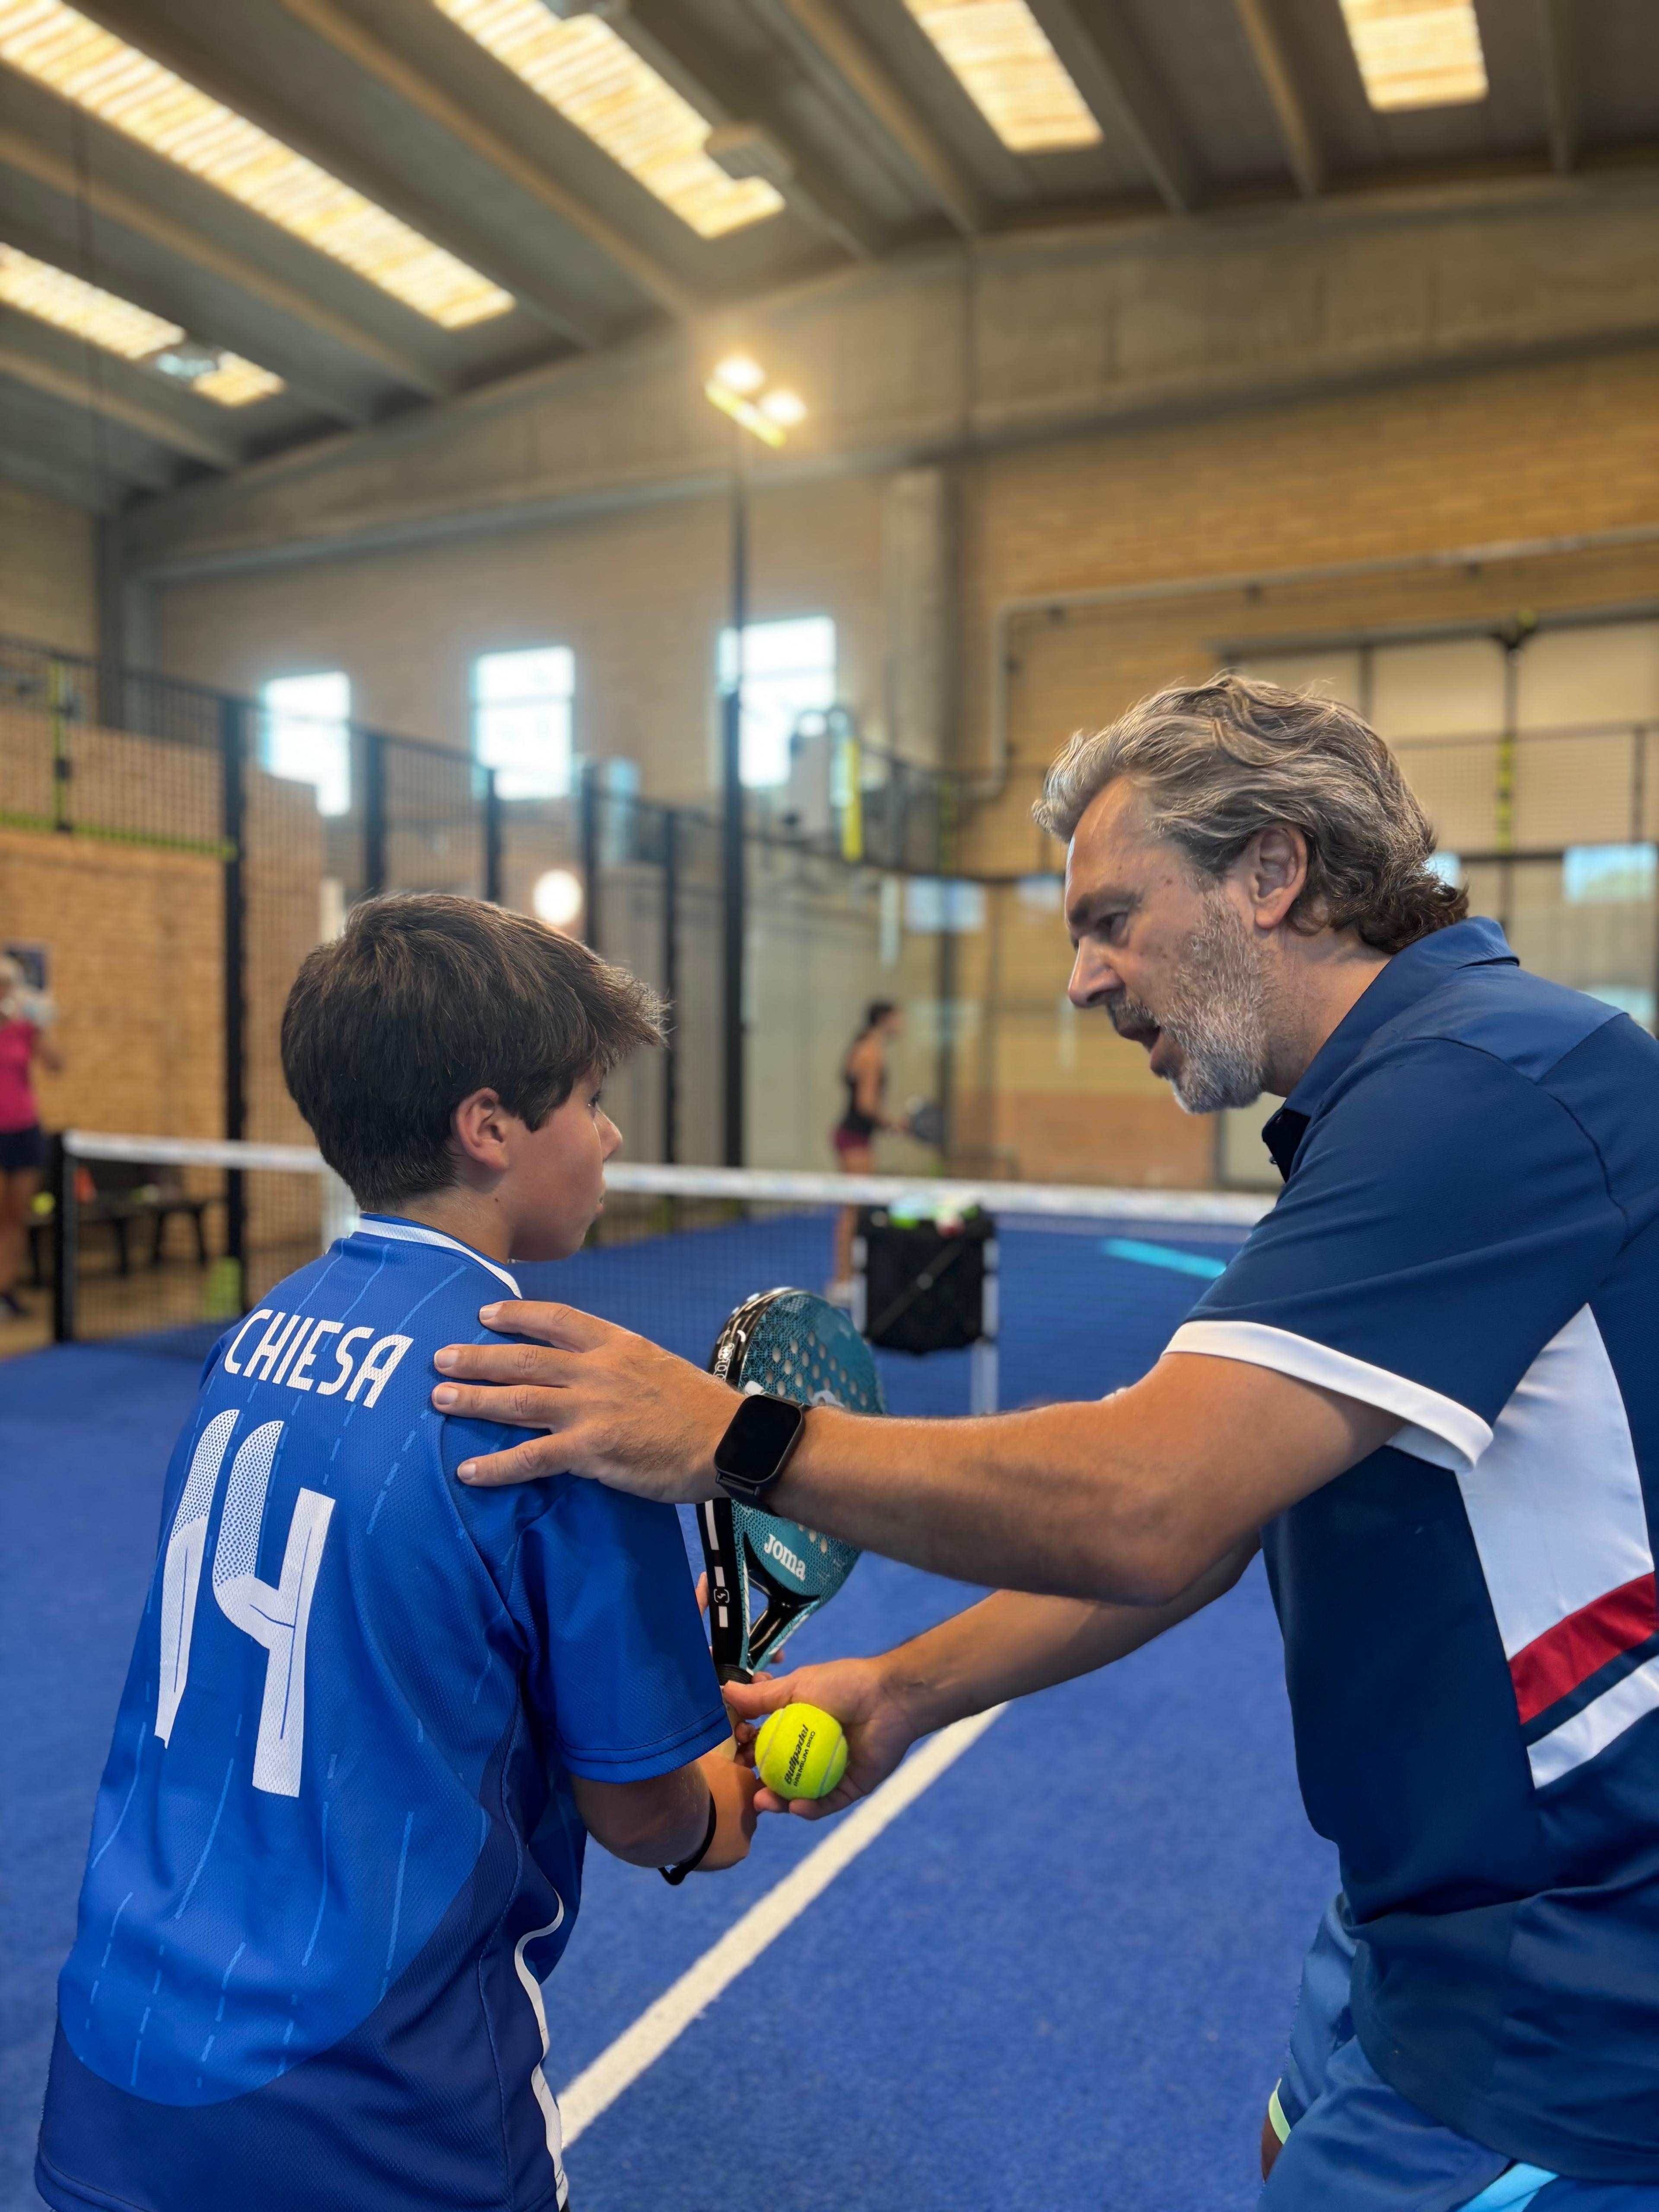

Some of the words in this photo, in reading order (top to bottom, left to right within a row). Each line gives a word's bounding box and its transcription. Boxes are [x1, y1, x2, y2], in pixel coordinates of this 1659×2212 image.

[225, 1308, 414, 1408] CHIESA
[764, 1533, 806, 1581] Joma
[155, 1409, 336, 1798] 14
[785, 1724, 808, 1784] Bullpadel
[794, 1749, 809, 1786] PREMIUM
[807, 1731, 815, 1747] PRO
